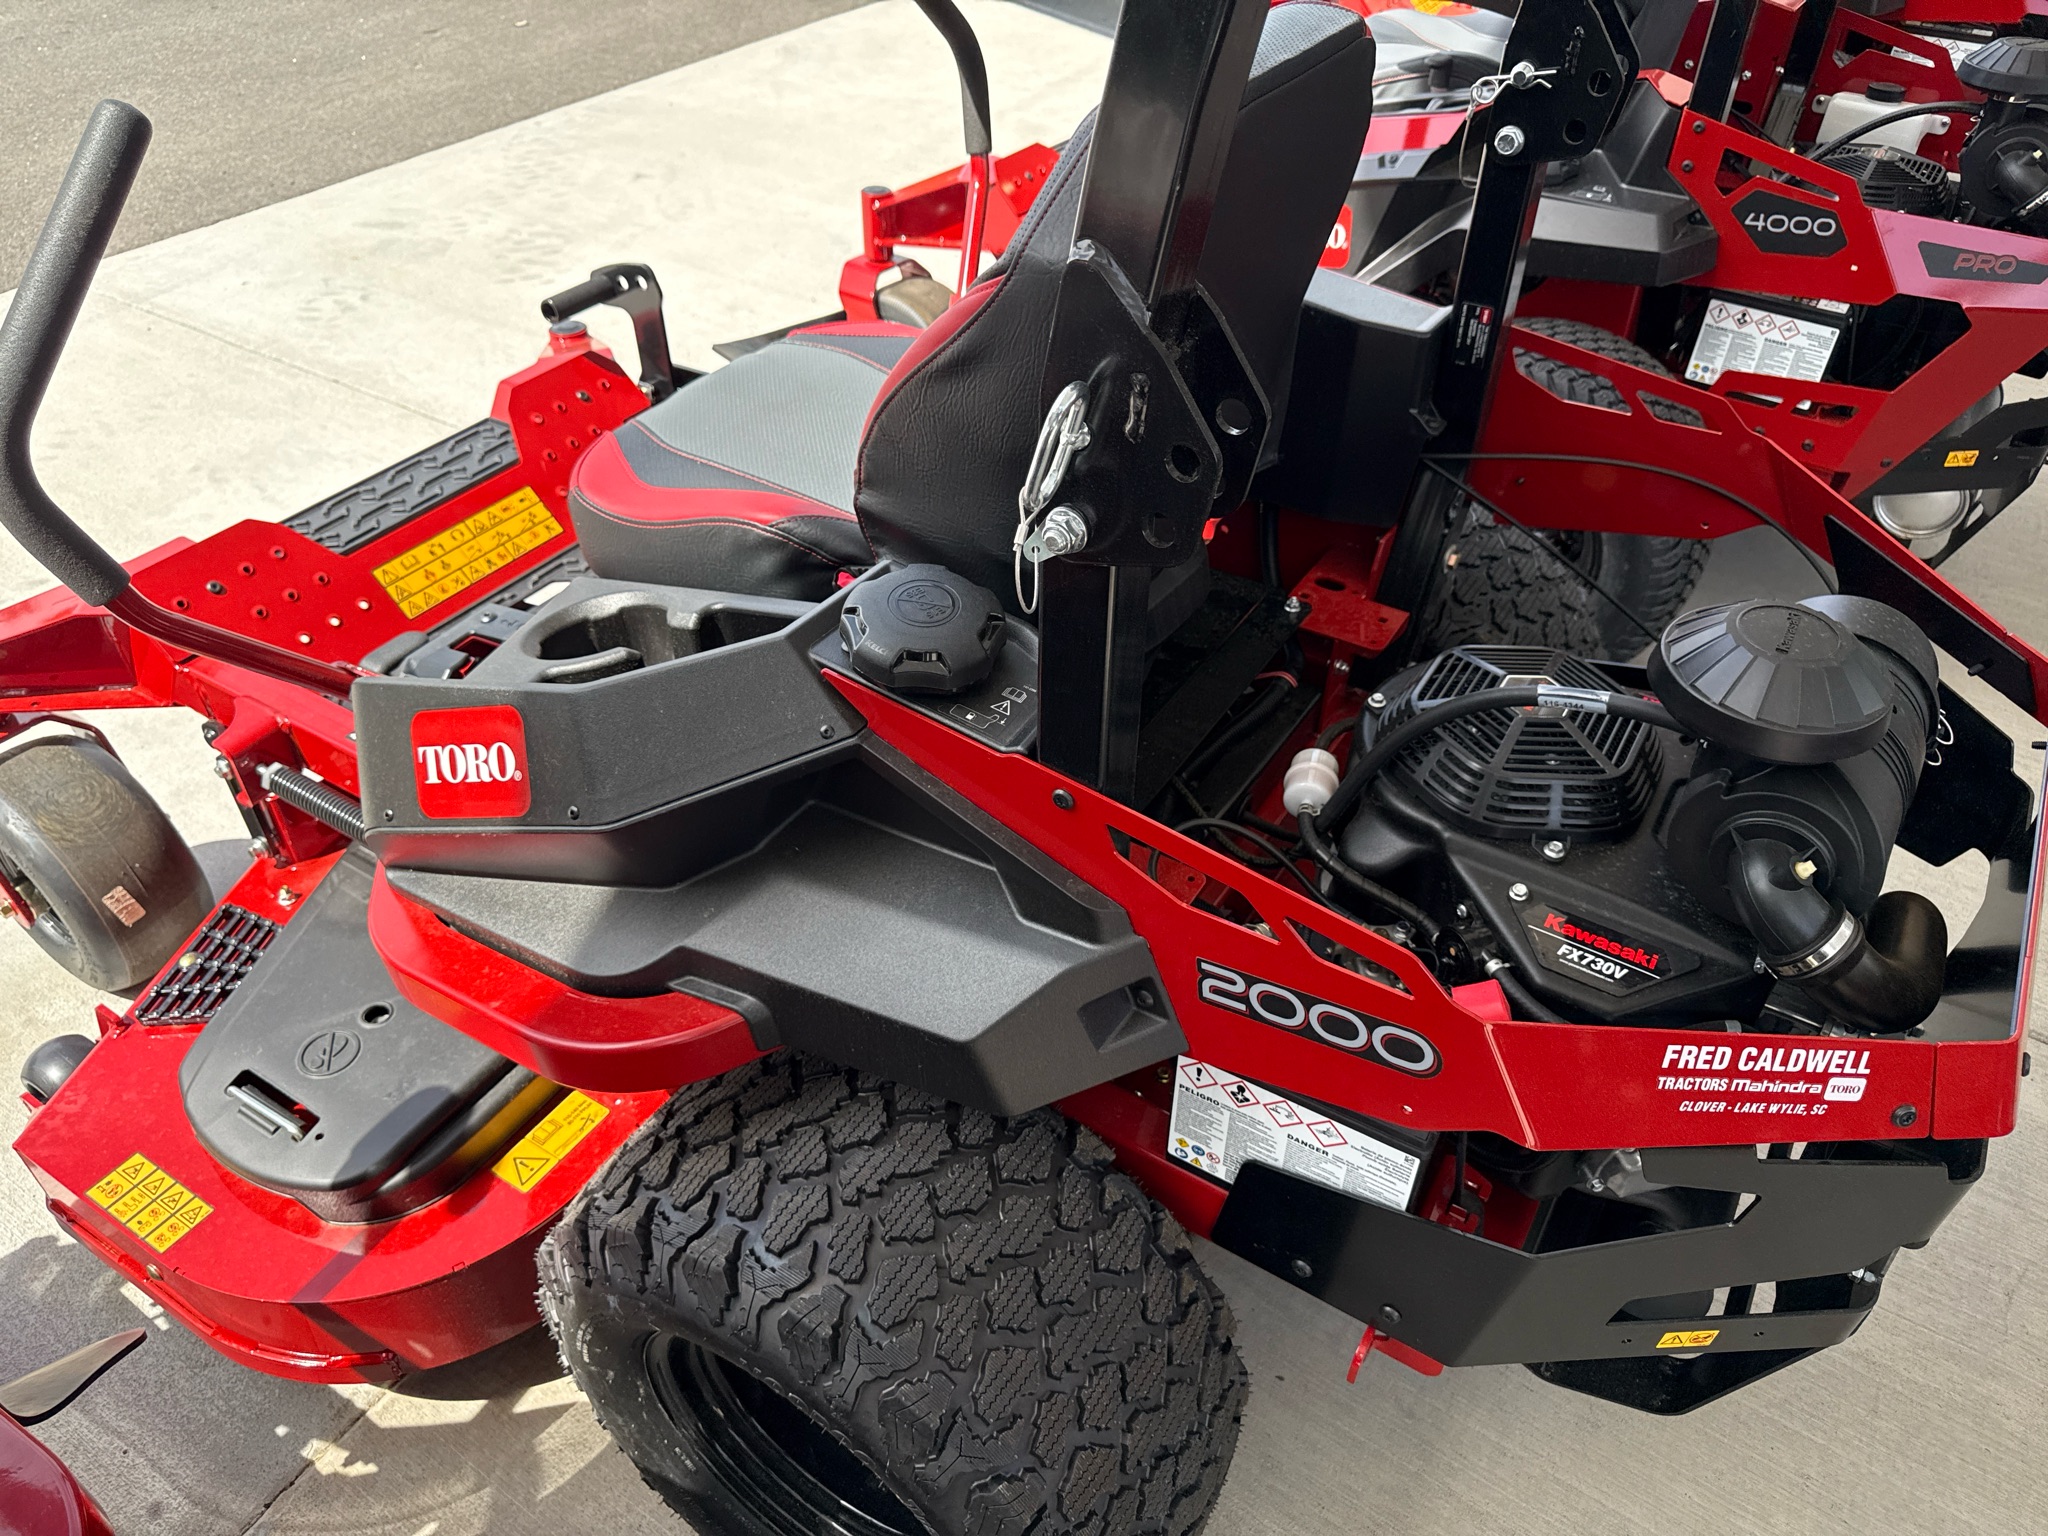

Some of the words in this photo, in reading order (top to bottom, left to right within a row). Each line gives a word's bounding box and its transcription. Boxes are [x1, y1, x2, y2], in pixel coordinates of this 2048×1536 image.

[1744, 212, 1837, 237] 4000
[1953, 252, 2018, 275] PRO
[1543, 912, 1660, 971] Kawasaki
[1556, 944, 1630, 980] FX730V
[1200, 961, 1436, 1073] 2000
[1661, 1044, 1733, 1071] FRED
[1737, 1046, 1871, 1075] CALDWELL
[1178, 1082, 1221, 1107] PELIGRO
[1656, 1076, 1729, 1092] TRACTORS
[1730, 1078, 1823, 1094] Mahindra
[1830, 1084, 1862, 1095] TORO
[1678, 1100, 1726, 1113] CLOVER
[1734, 1102, 1766, 1114] LAKE
[1768, 1103, 1807, 1116] WYLIE,
[1810, 1104, 1829, 1116] SC
[1286, 1132, 1330, 1158] DANGER
